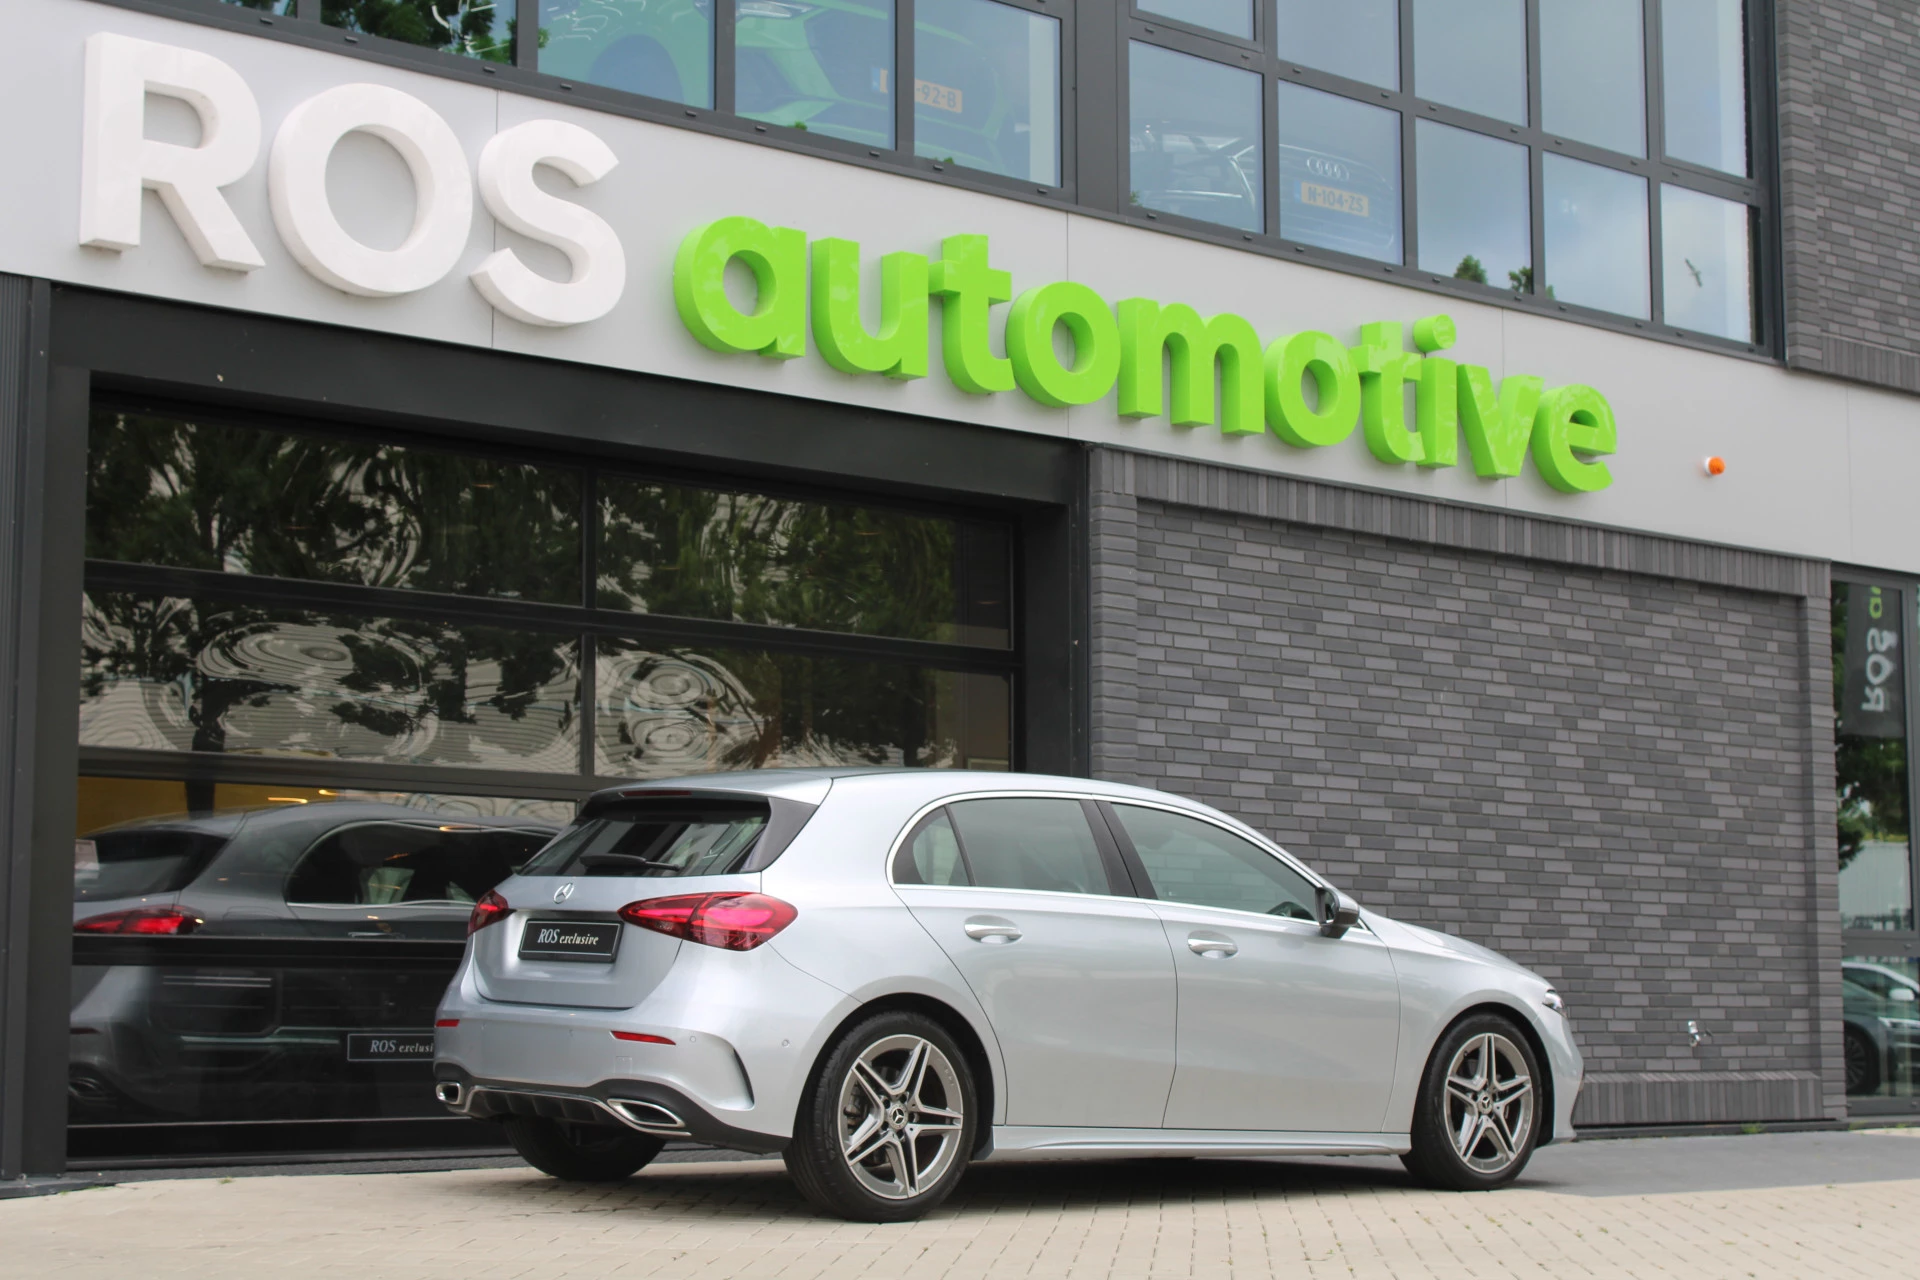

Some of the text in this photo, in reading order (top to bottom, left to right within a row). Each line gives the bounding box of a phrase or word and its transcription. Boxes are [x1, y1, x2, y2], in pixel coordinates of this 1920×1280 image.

[915, 84, 957, 109] -92-B
[80, 32, 1618, 494] ROS automotive
[537, 928, 599, 945] ROS exclusive
[369, 1040, 434, 1053] ROS exclusi
